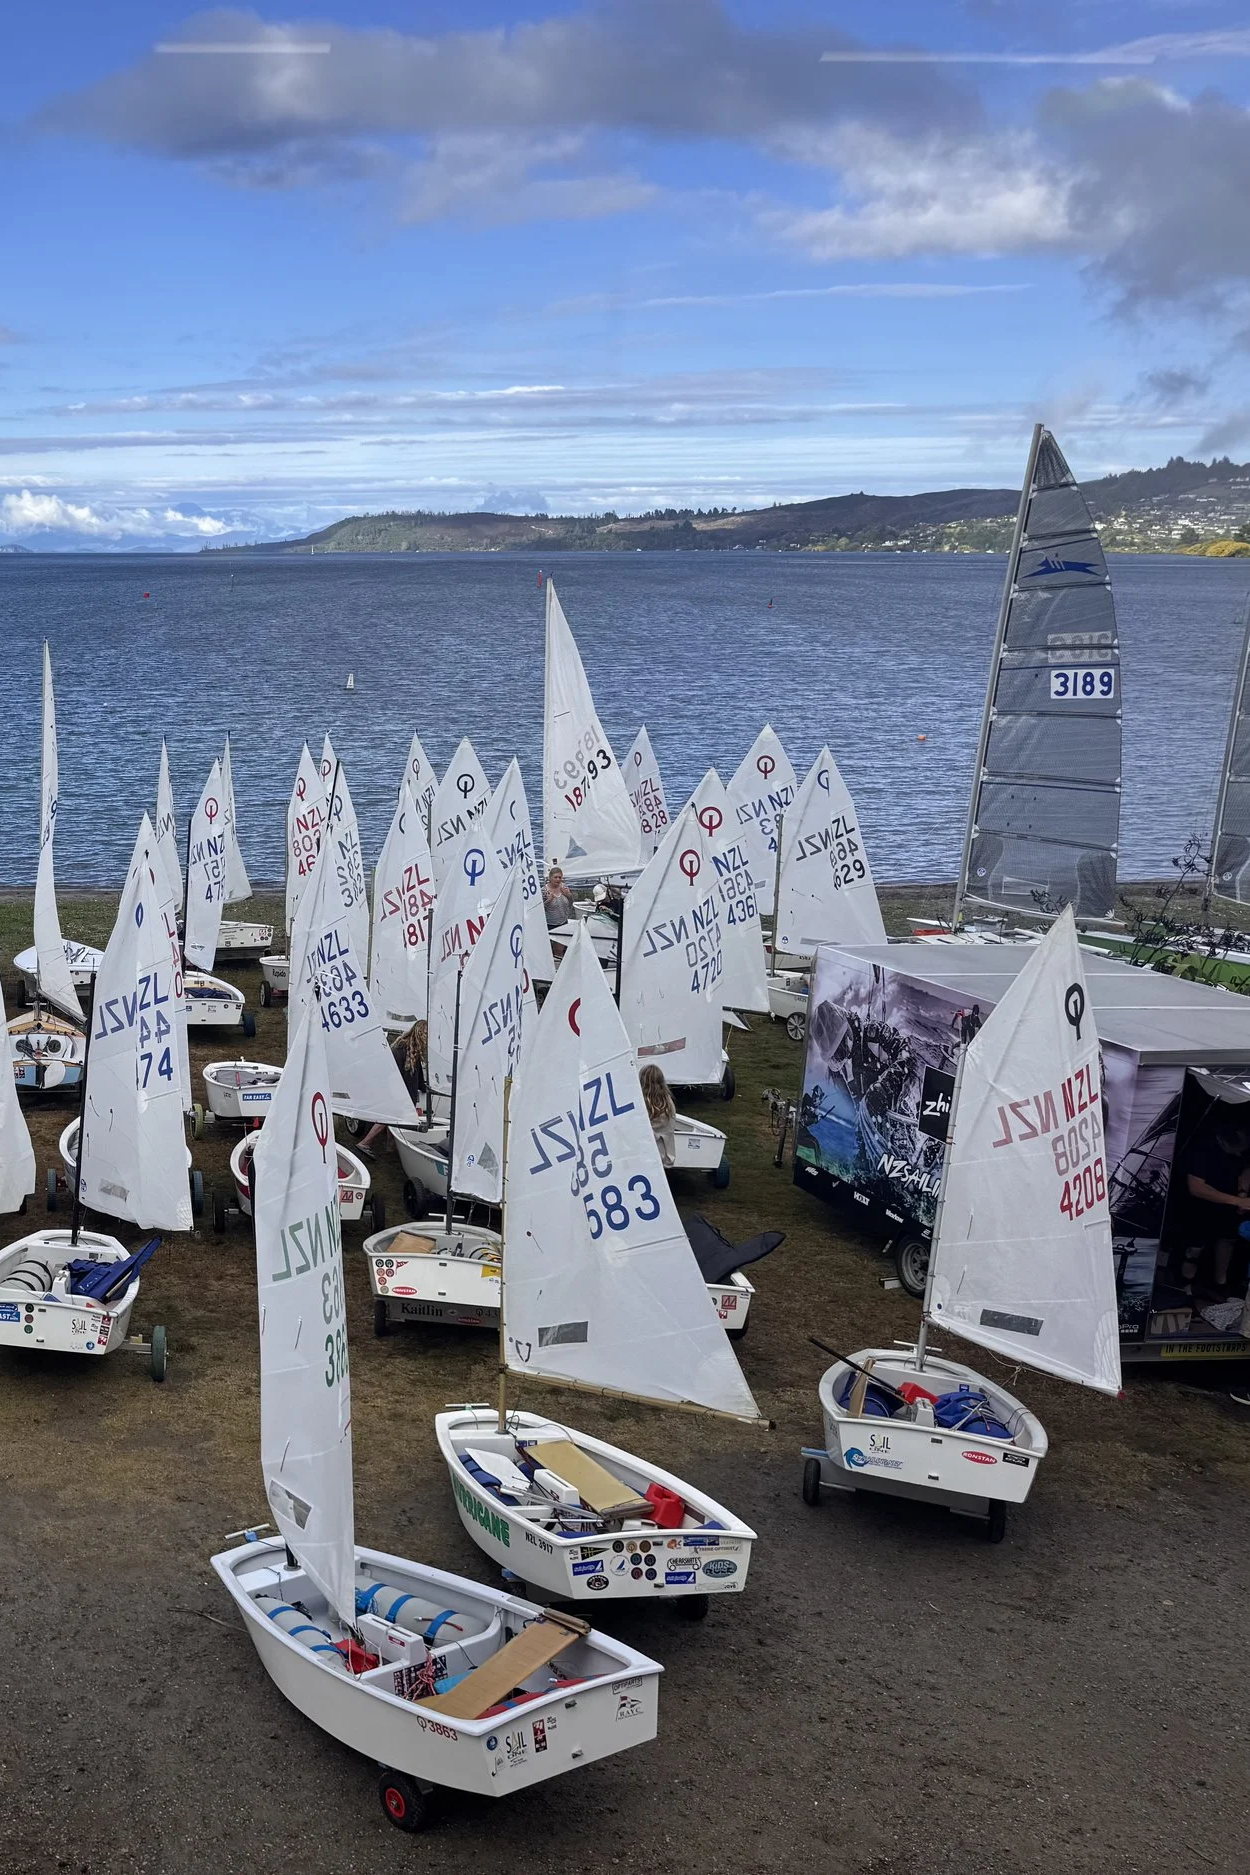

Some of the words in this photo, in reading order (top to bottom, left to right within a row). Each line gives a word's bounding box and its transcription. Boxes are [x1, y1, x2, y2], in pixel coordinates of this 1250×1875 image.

[1053, 671, 1112, 697] 3189
[639, 777, 660, 800] ZL
[296, 806, 326, 834] NZL
[514, 829, 531, 855] ZL
[712, 844, 749, 878] NZL
[403, 863, 430, 895] ZL
[691, 895, 720, 934] NZL
[727, 892, 759, 926] 4361
[317, 929, 349, 968] NZL
[272, 968, 287, 979] Rapido
[691, 949, 723, 994] 4720
[136, 972, 169, 1012] ZL
[579, 1072, 635, 1132] ZL
[1061, 1064, 1099, 1123] NZL
[1060, 1157, 1106, 1221] 4208
[583, 1174, 661, 1240] 583
[401, 1302, 443, 1317] Kaitlin
[1165, 1344, 1174, 1353] IN
[1178, 1343, 1193, 1353] THE
[1195, 1342, 1247, 1353] FOOTSTRAPS
[962, 1452, 996, 1463] RONSTAN
[525, 1531, 537, 1546] NZL
[538, 1538, 554, 1555] 3917
[427, 1719, 458, 1742] 3863
